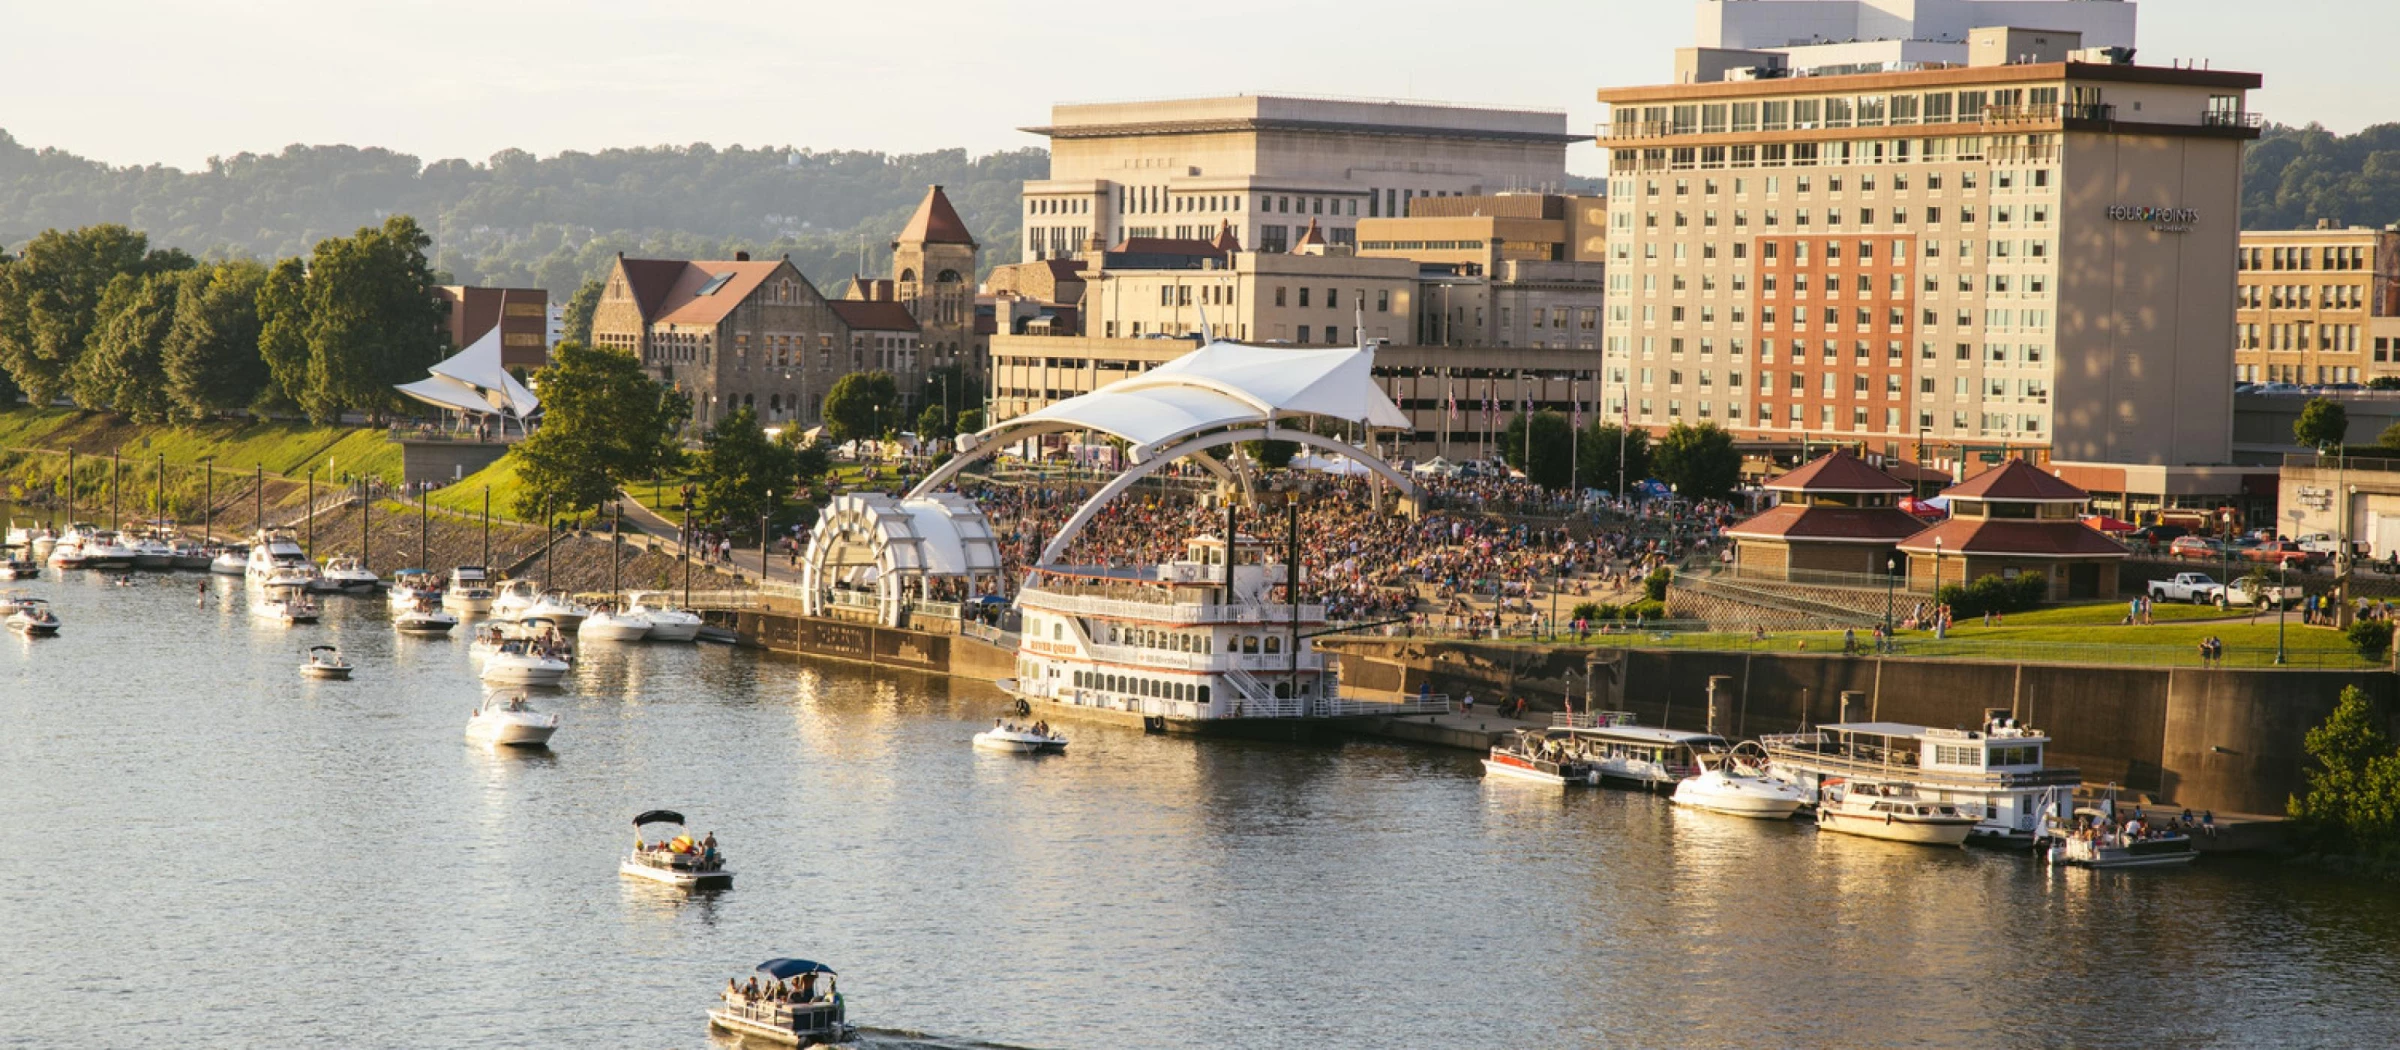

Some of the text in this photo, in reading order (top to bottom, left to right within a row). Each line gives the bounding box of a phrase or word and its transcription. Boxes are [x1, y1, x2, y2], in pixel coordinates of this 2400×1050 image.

[2108, 205, 2200, 222] FOUR POINTS
[1053, 643, 1077, 654] QUEEN
